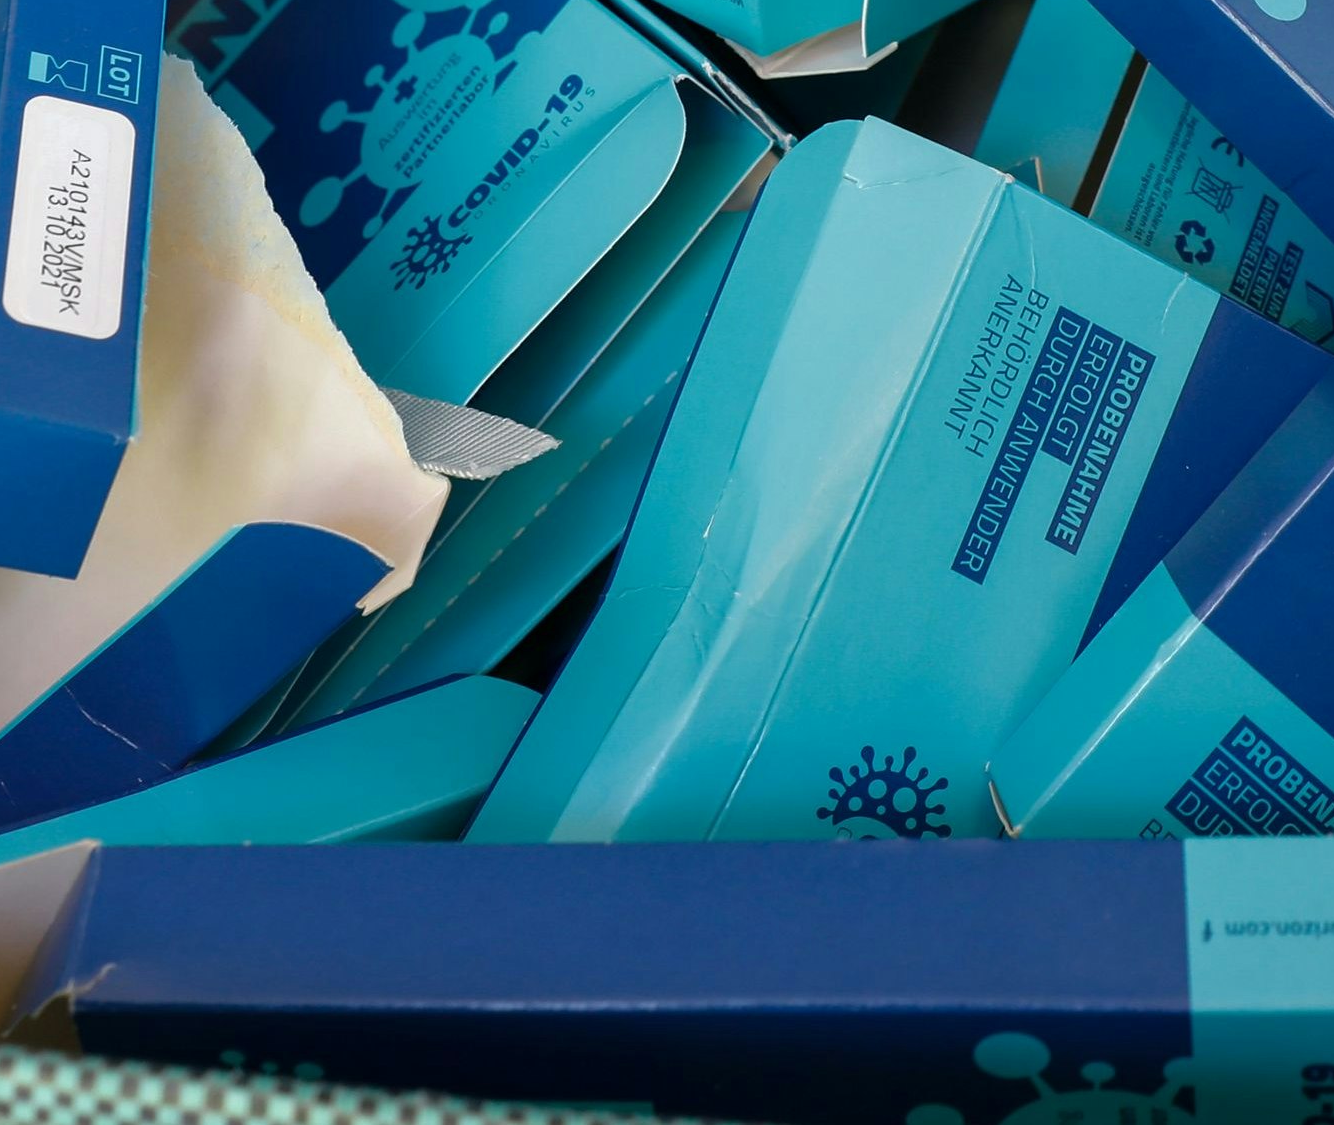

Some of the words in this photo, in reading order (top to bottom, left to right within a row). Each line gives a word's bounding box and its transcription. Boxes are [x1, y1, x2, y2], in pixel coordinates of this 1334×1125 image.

[107, 54, 132, 97] LOT
[378, 52, 463, 152] Auswertung
[394, 64, 482, 173] zertifizierten
[418, 97, 439, 120] im
[447, 73, 584, 228] COVID-19
[461, 86, 596, 233] CORONAVIRUS
[41, 185, 68, 291] 13.10.2021
[59, 149, 92, 316] A210143V/MSK
[1235, 199, 1278, 299] ANGEMELDET
[1250, 250, 1281, 312] PATENT
[1266, 280, 1290, 322] ZUM
[944, 273, 1024, 441] ANERKANNT
[964, 288, 1050, 459] BEHÖRDLICH
[1027, 315, 1081, 413] DURCH
[1052, 332, 1115, 457] ERFOLGT
[962, 412, 1040, 573] ANWENDER
[1053, 351, 1148, 546] PROBENAHME
